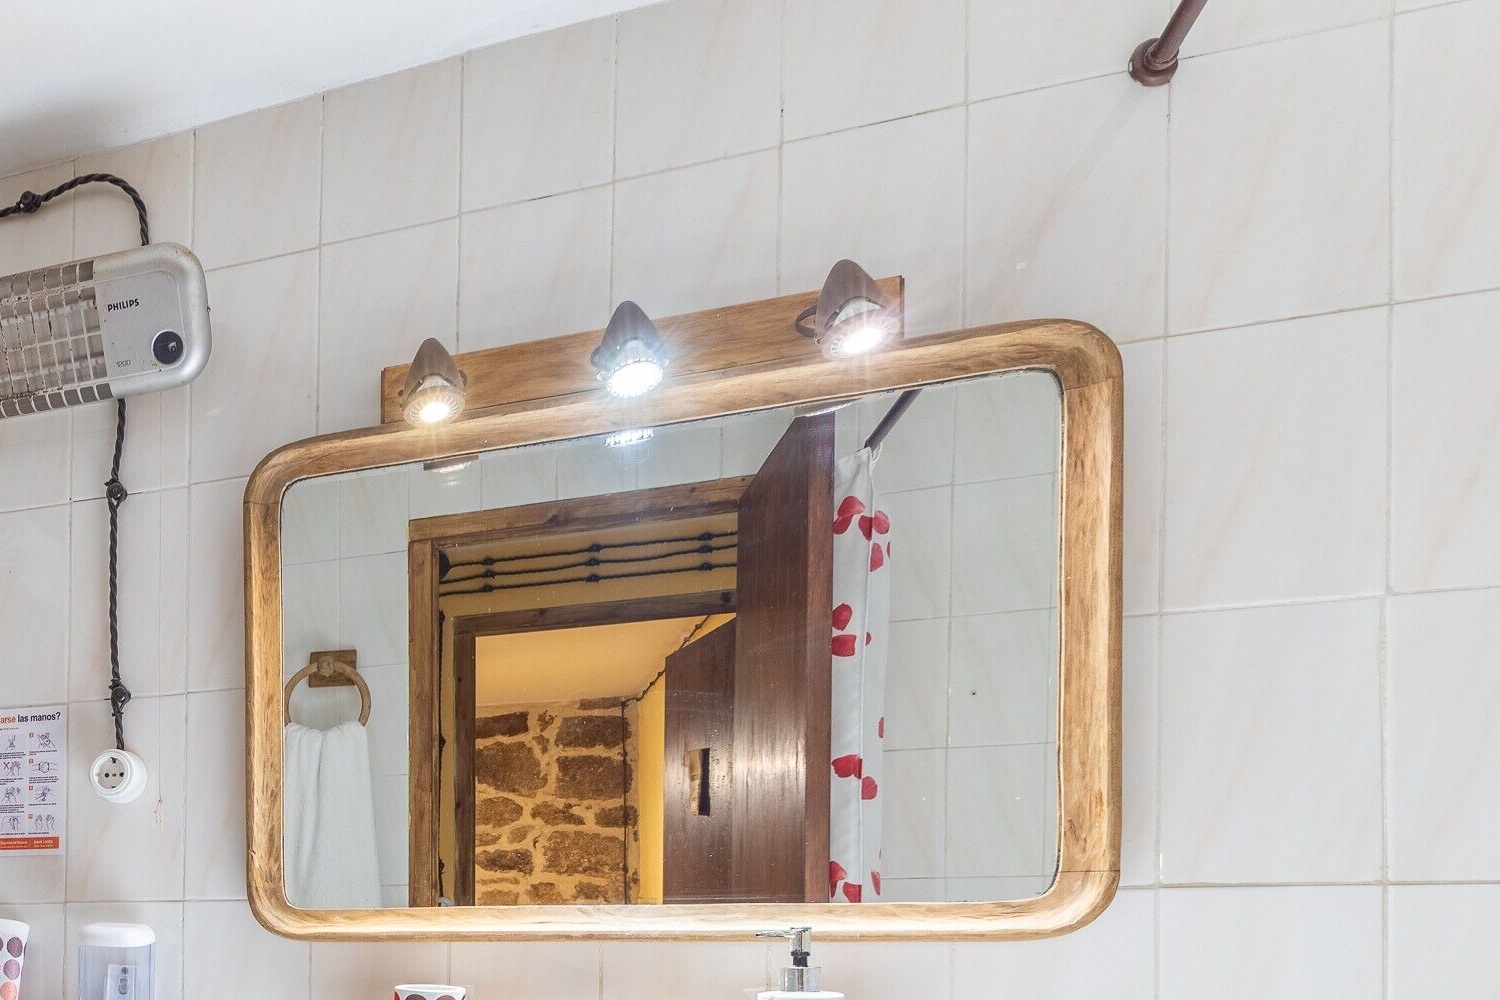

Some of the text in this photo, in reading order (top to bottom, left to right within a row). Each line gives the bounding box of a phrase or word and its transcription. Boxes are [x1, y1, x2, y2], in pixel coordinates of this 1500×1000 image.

[107, 298, 140, 312] PHILIPS
[17, 714, 29, 723] las
[30, 711, 61, 722] manos?
